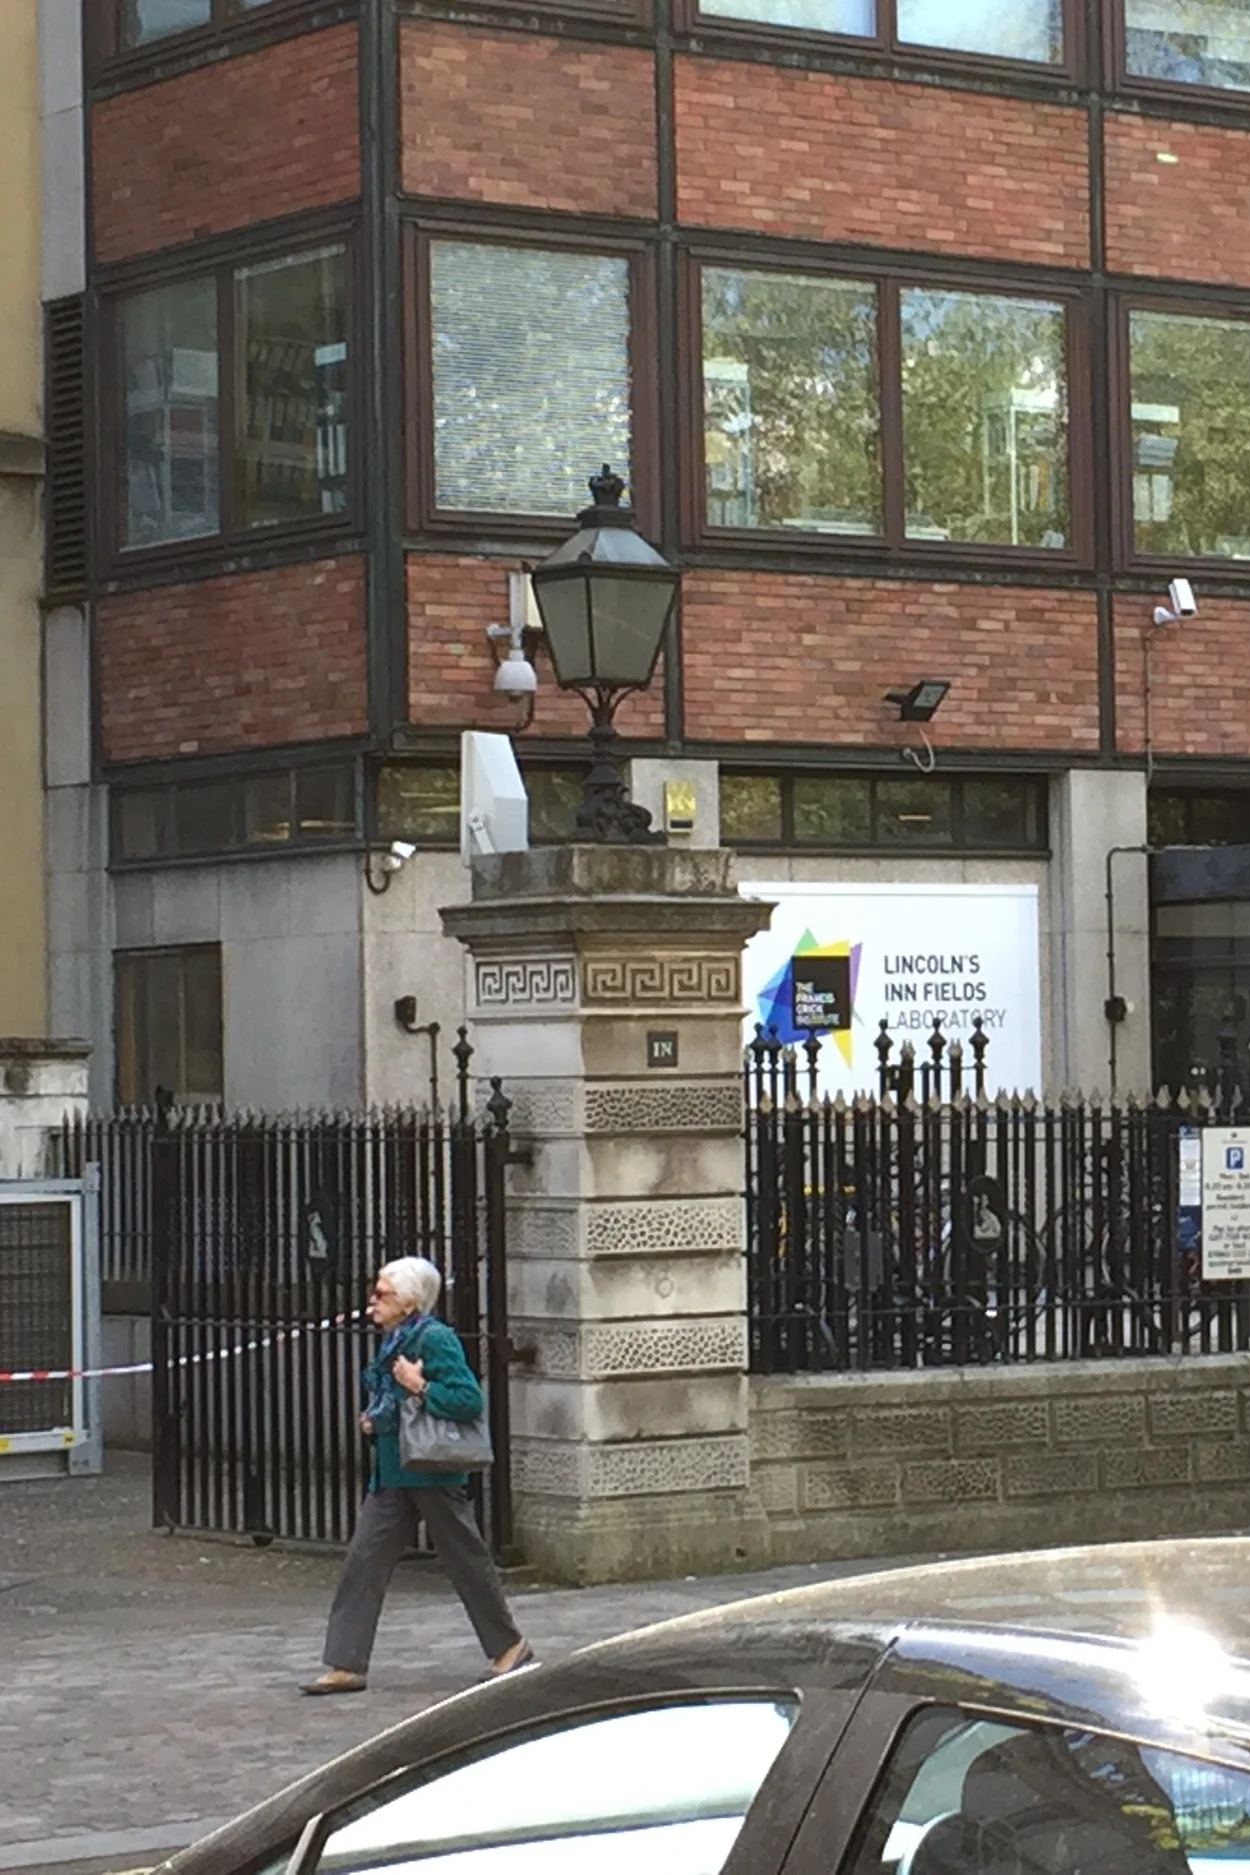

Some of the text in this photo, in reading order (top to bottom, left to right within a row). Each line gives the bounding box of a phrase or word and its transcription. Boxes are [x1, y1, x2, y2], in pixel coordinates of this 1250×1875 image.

[883, 954, 981, 975] LINCOLN'S
[884, 982, 987, 1002] INN FIELDS
[885, 1009, 1007, 1030] LABORATORY
[653, 1041, 673, 1058] IN
